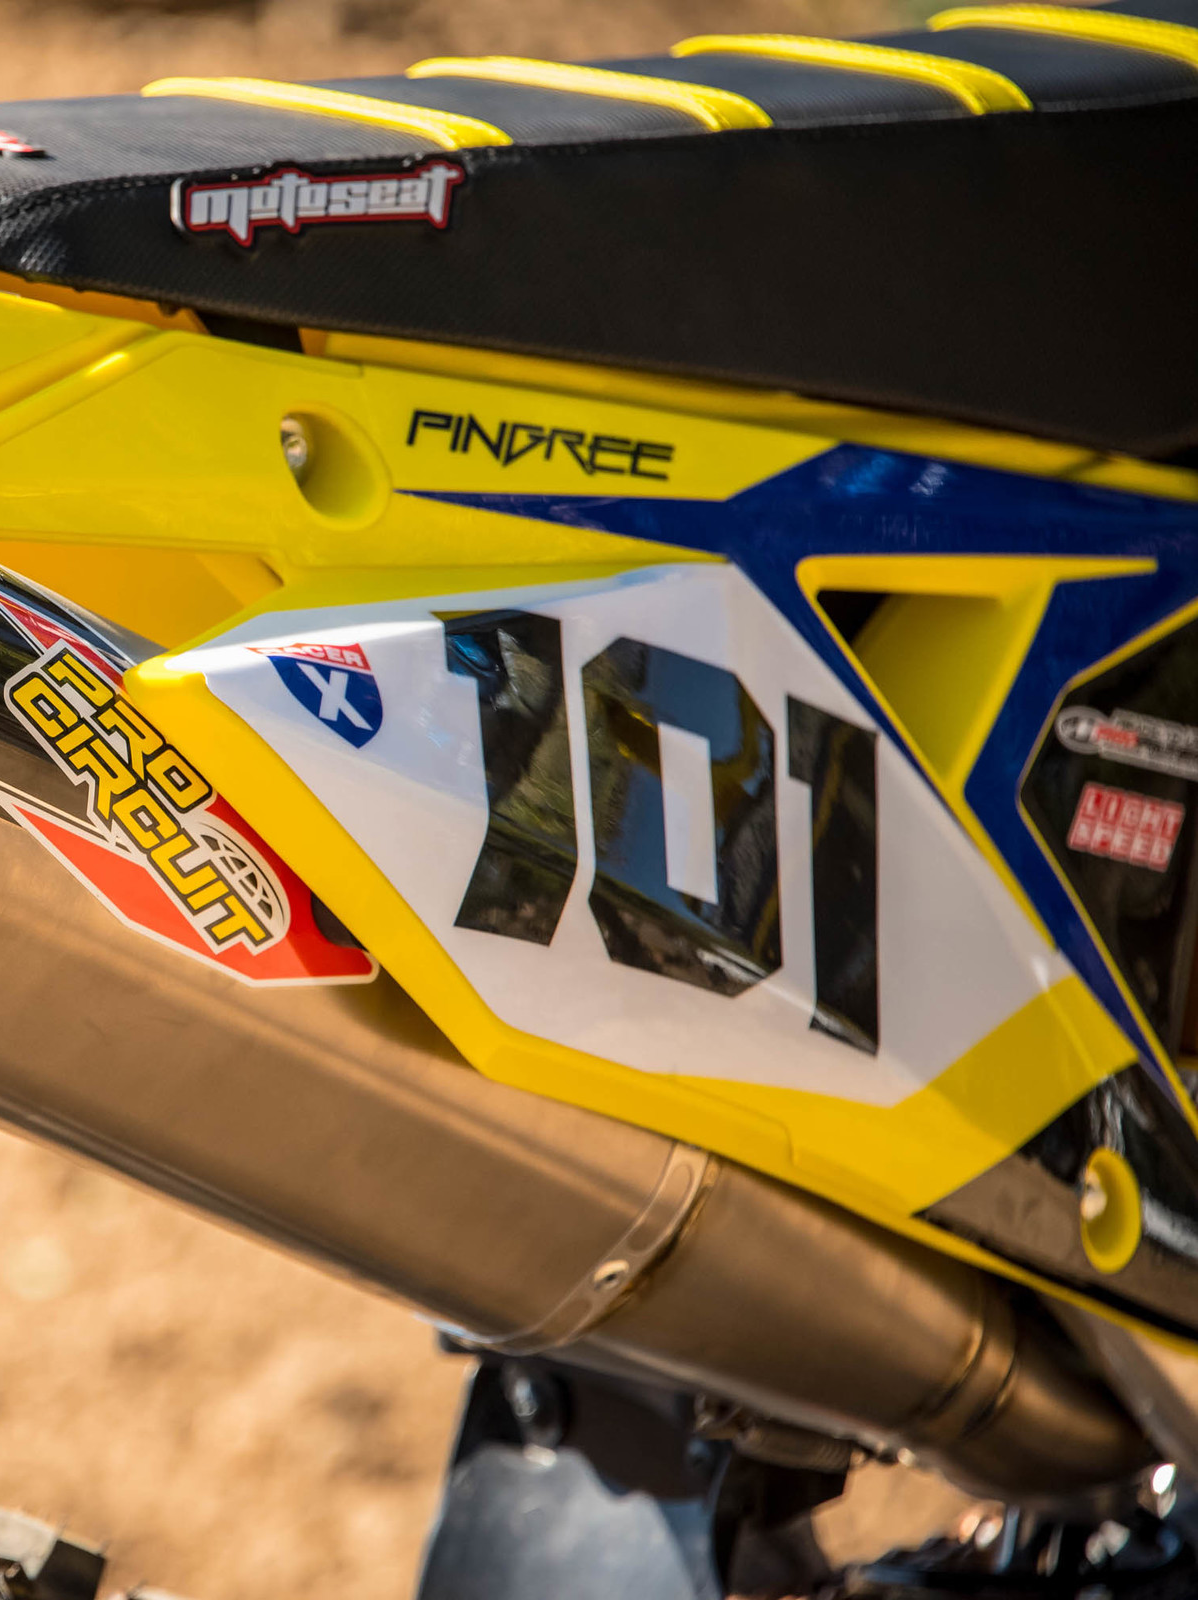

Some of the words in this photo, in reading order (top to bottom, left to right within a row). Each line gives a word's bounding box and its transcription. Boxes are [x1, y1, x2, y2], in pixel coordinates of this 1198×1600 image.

[188, 163, 461, 243] motoseat
[407, 408, 675, 481] PINGREE
[41, 649, 212, 812] PRO
[296, 662, 374, 732] X
[10, 673, 273, 946] CIRCUIT
[432, 608, 881, 1058] 101
[1072, 819, 1173, 870] SPEED
[1082, 787, 1182, 839] LIGHT
